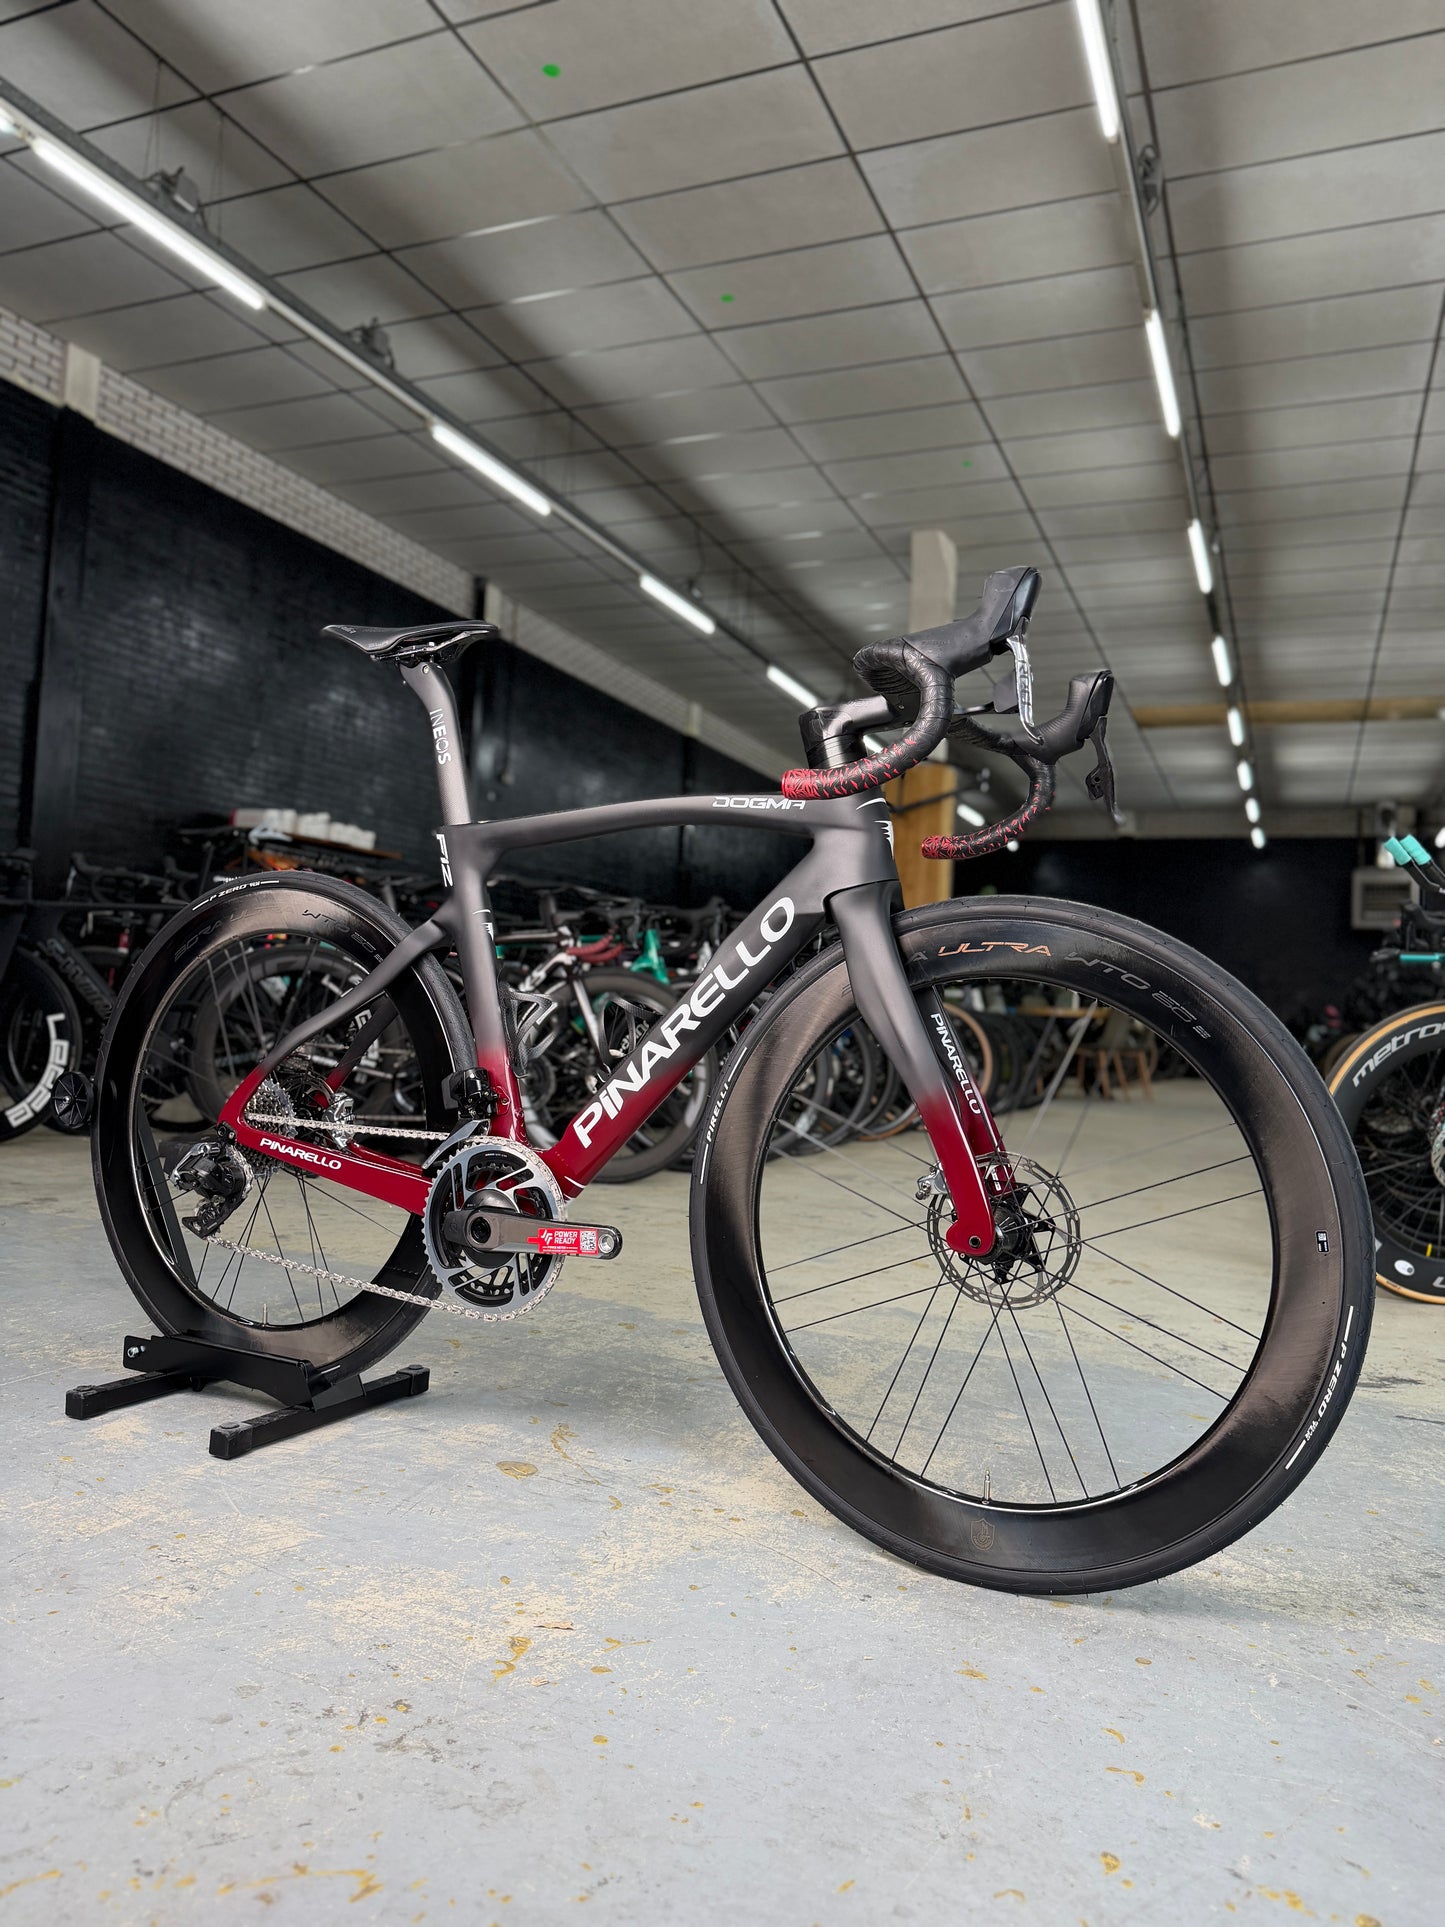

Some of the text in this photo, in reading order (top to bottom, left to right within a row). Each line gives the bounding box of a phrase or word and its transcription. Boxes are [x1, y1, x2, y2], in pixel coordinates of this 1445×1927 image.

[430, 708, 452, 765] INEOS
[712, 796, 806, 810] DOGMA
[218, 884, 247, 898] ZERO
[937, 941, 1052, 958] ULTRA
[1063, 951, 1151, 990] WTO
[573, 896, 796, 1149] PINARELLO
[930, 1012, 981, 1115] PINARELLO
[1352, 1022, 1445, 1089] metro
[706, 1082, 729, 1142] PIRELLI
[260, 1137, 342, 1170] PINARELLO
[554, 1230, 578, 1238] POWER
[1317, 1359, 1343, 1418] ZERO
